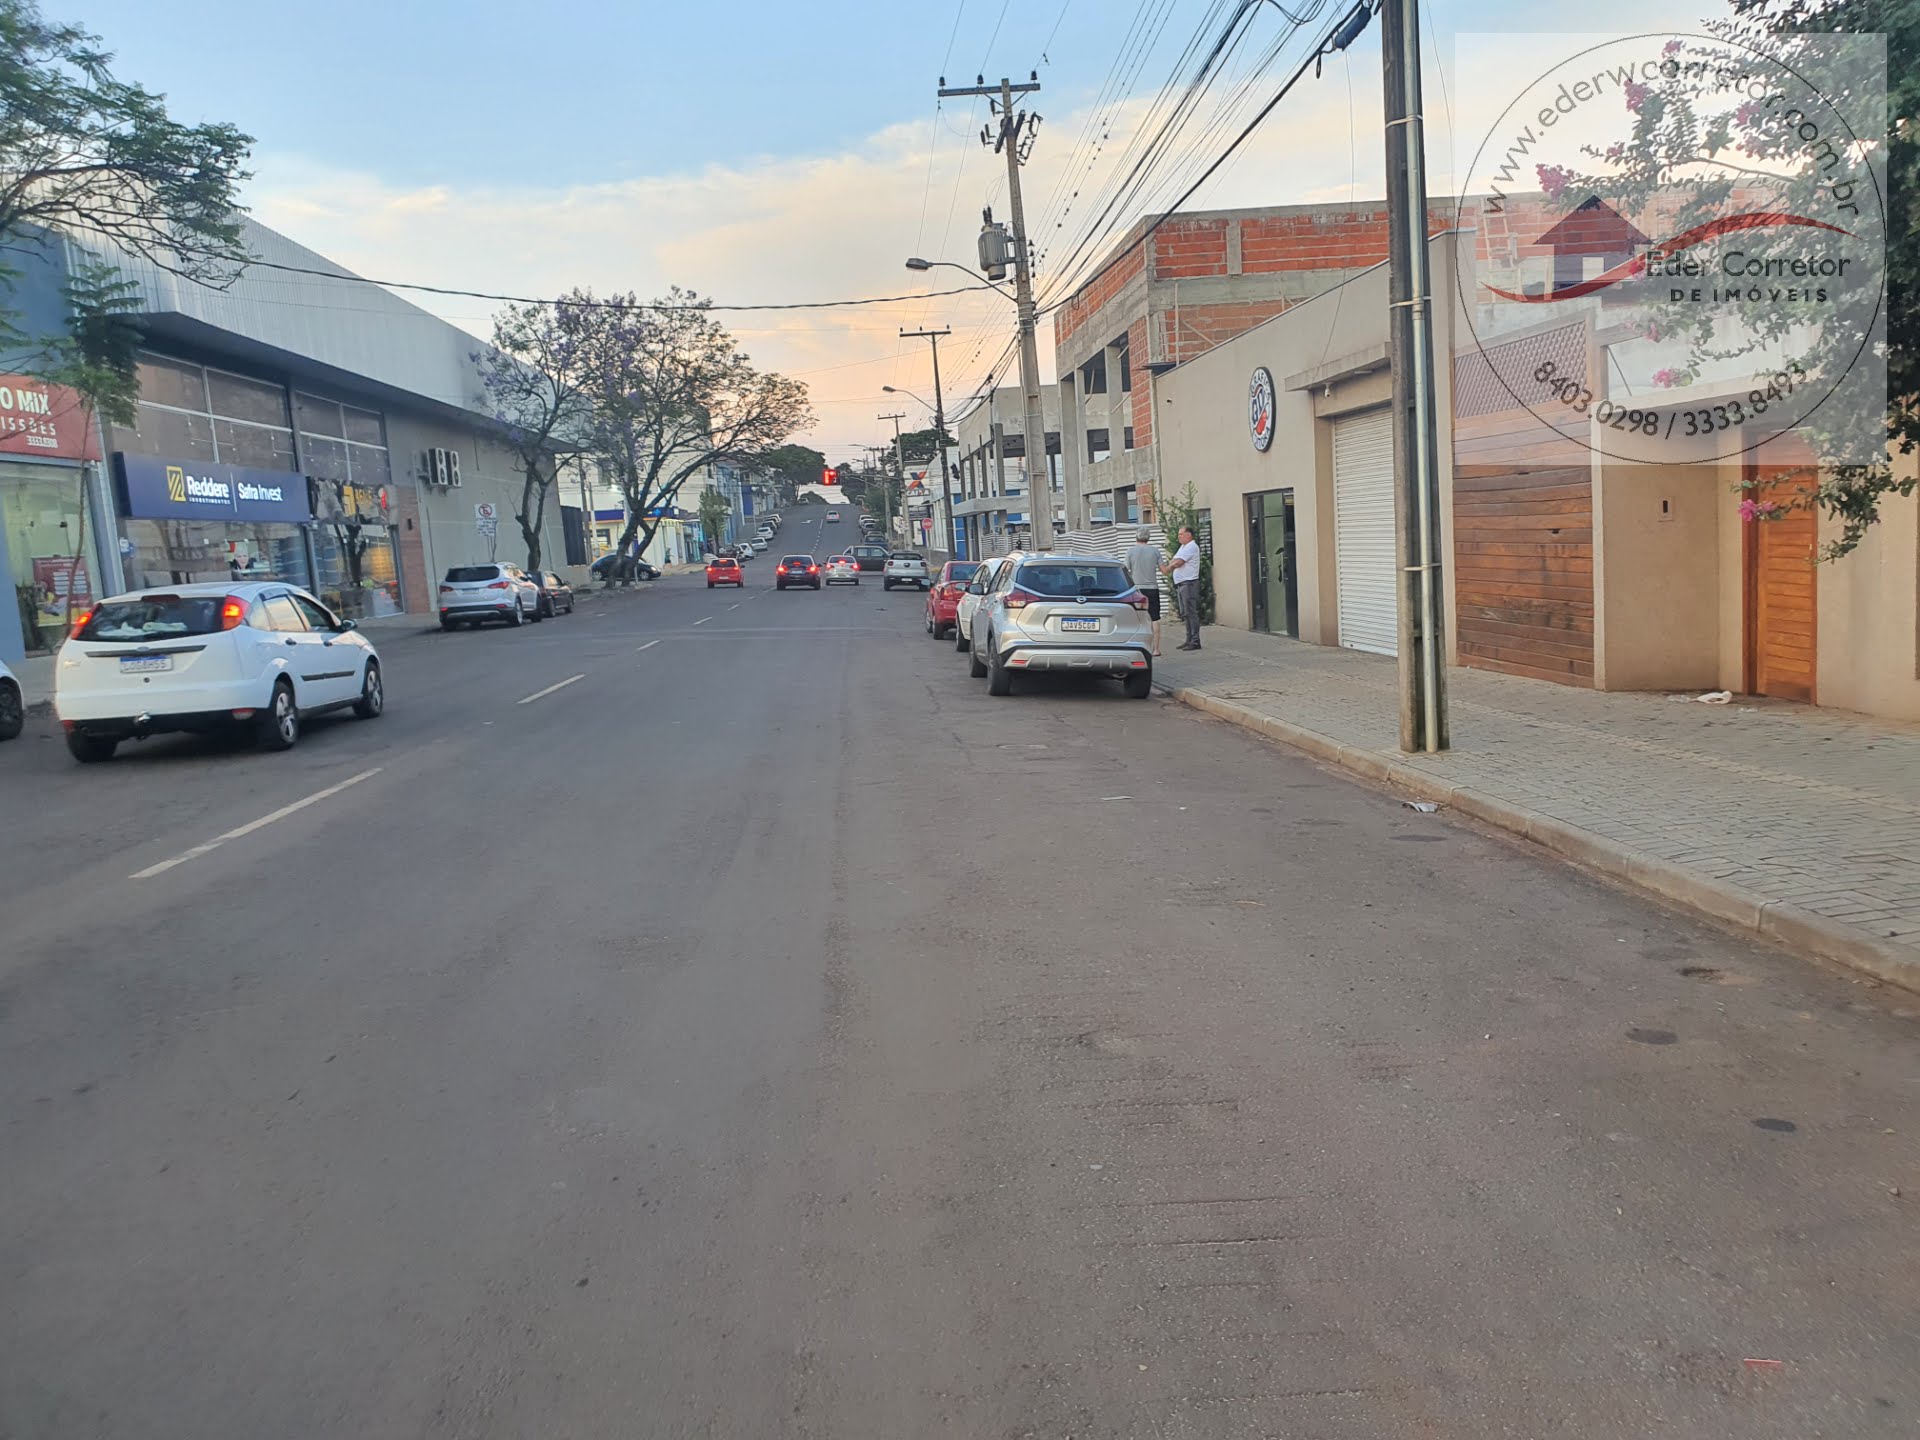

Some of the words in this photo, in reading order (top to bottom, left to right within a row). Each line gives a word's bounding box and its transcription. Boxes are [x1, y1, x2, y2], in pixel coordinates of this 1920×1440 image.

[186, 475, 230, 498] Reddere
[238, 482, 259, 500] Safra
[258, 484, 283, 502] Invest
